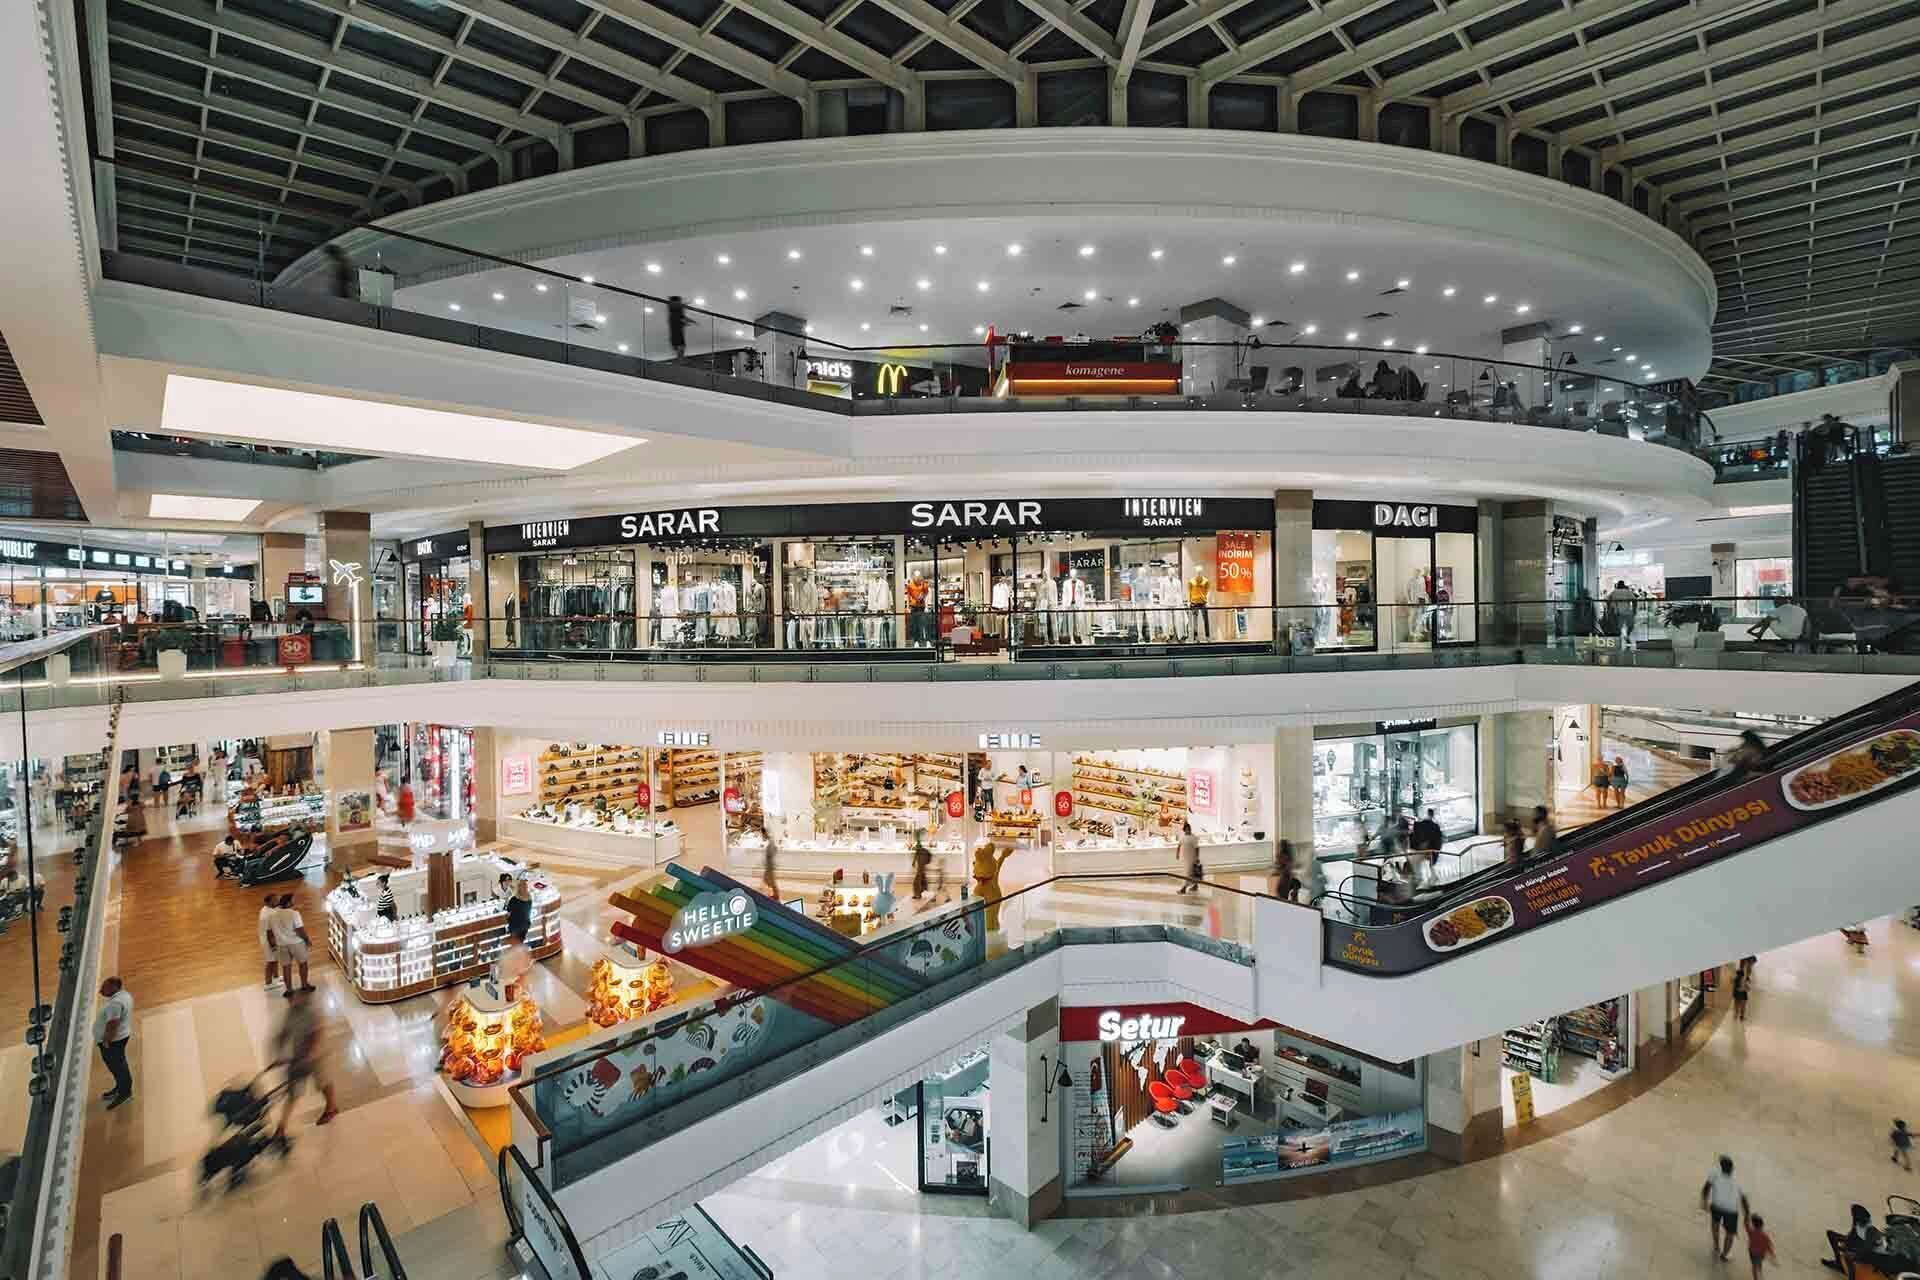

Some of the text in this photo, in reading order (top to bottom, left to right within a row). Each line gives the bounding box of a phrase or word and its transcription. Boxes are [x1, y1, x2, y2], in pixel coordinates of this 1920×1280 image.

[1065, 363, 1125, 378] komagene
[621, 509, 720, 538] SARAR
[911, 502, 1042, 527] SARAR
[1143, 517, 1183, 527] SARAR
[532, 538, 557, 547] SARAR
[1225, 541, 1247, 549] SALE
[1070, 557, 1104, 569] SARAR
[1058, 801, 1069, 809] 50
[1612, 799, 1772, 867] Tavuk Dünyası
[684, 896, 747, 926] HELLO
[672, 913, 752, 947] SWEETIE
[1099, 1010, 1186, 1041] Setur
